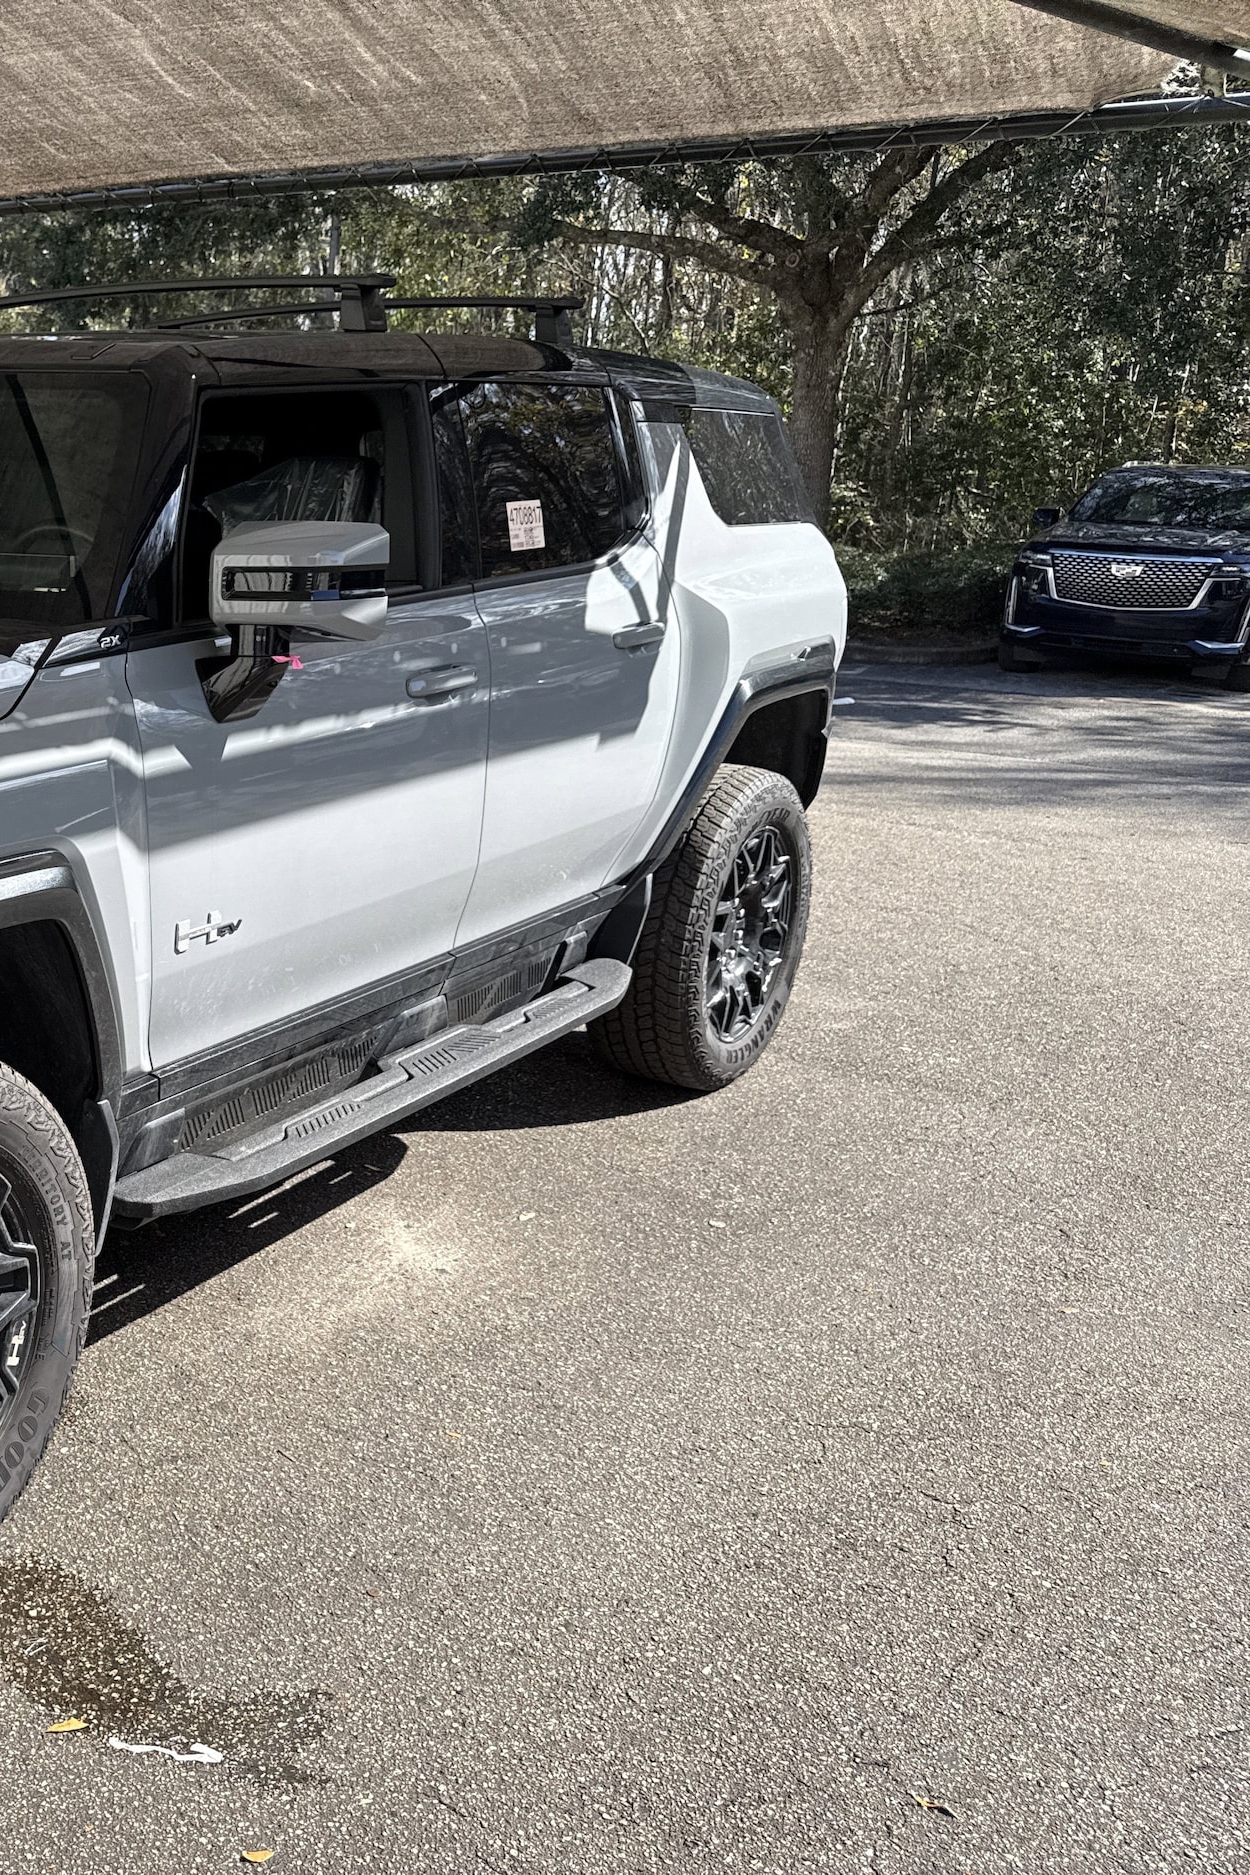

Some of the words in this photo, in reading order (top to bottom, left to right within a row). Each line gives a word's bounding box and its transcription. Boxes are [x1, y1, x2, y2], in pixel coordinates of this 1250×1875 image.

[100, 634, 121, 649] 2X
[725, 999, 781, 1065] WRANGLER
[18, 1144, 69, 1227] TERRITORY
[59, 1241, 72, 1262] AT
